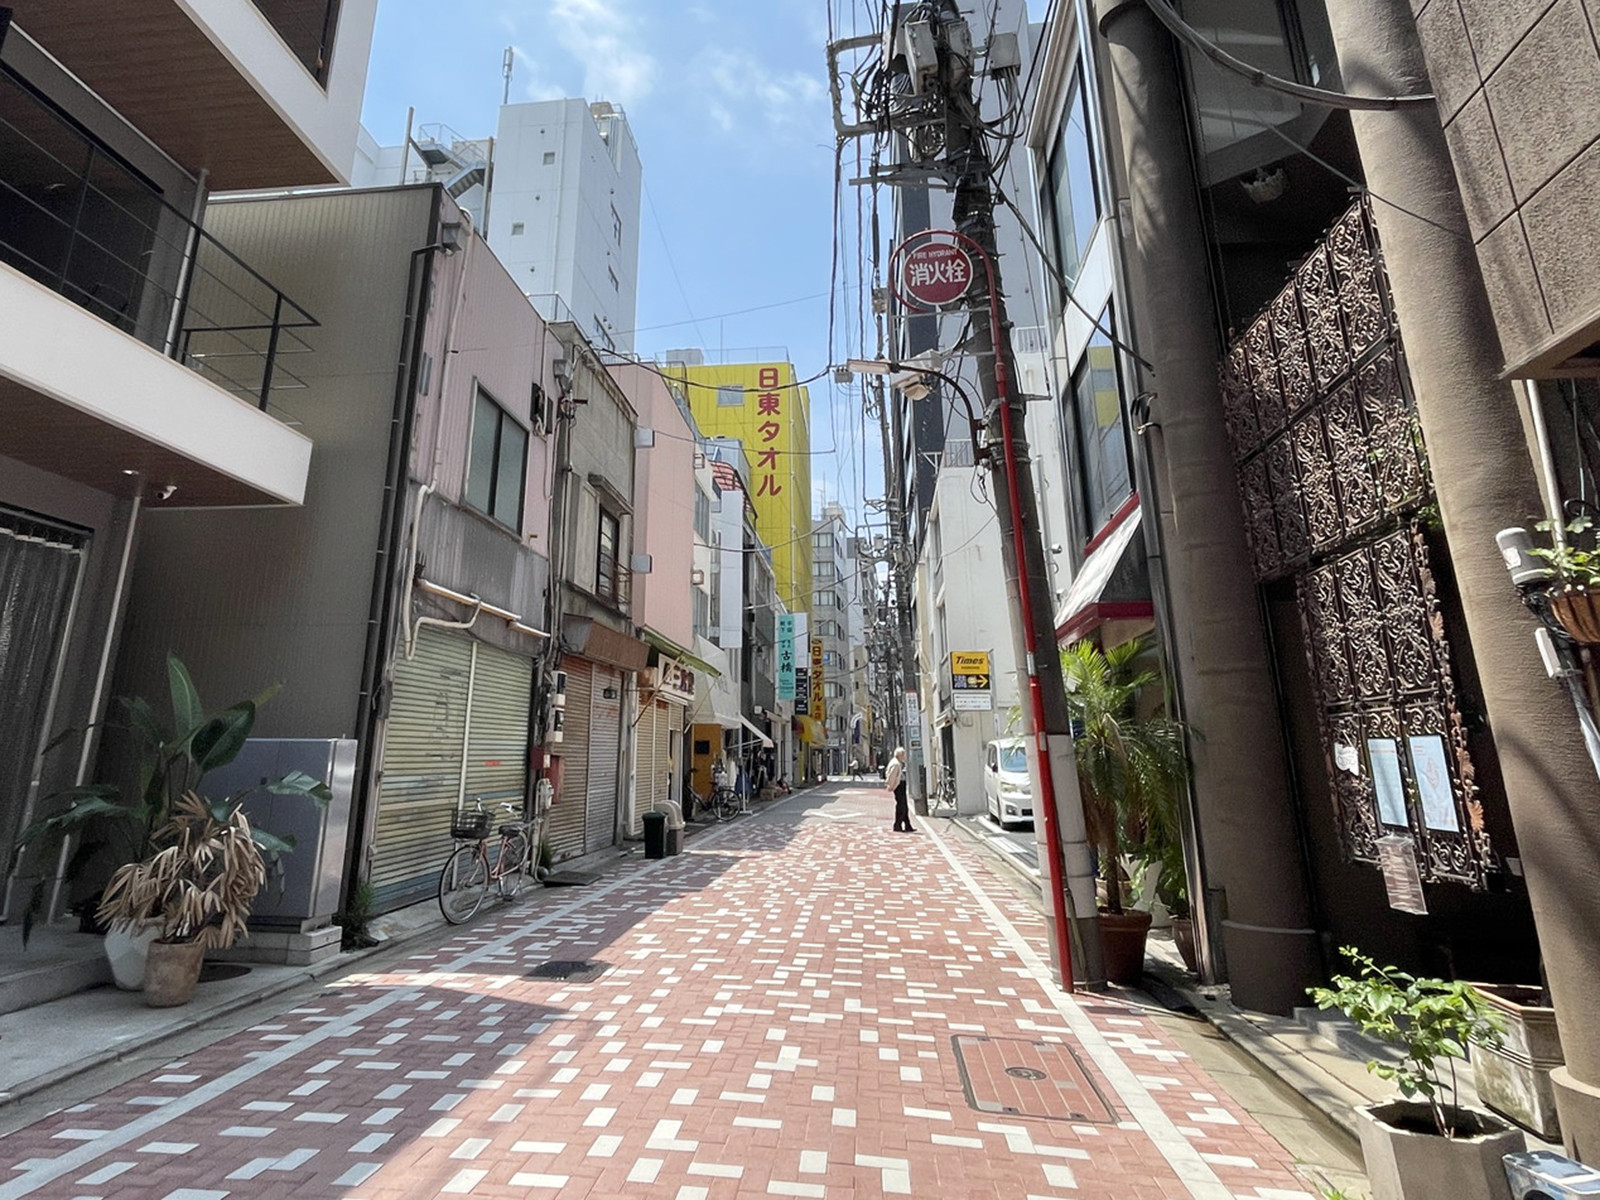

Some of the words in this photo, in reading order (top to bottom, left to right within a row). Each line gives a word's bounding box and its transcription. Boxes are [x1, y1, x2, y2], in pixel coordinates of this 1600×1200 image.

[909, 258, 967, 287] 消火栓
[757, 367, 782, 497] 日東タオル
[955, 656, 985, 665] Times
